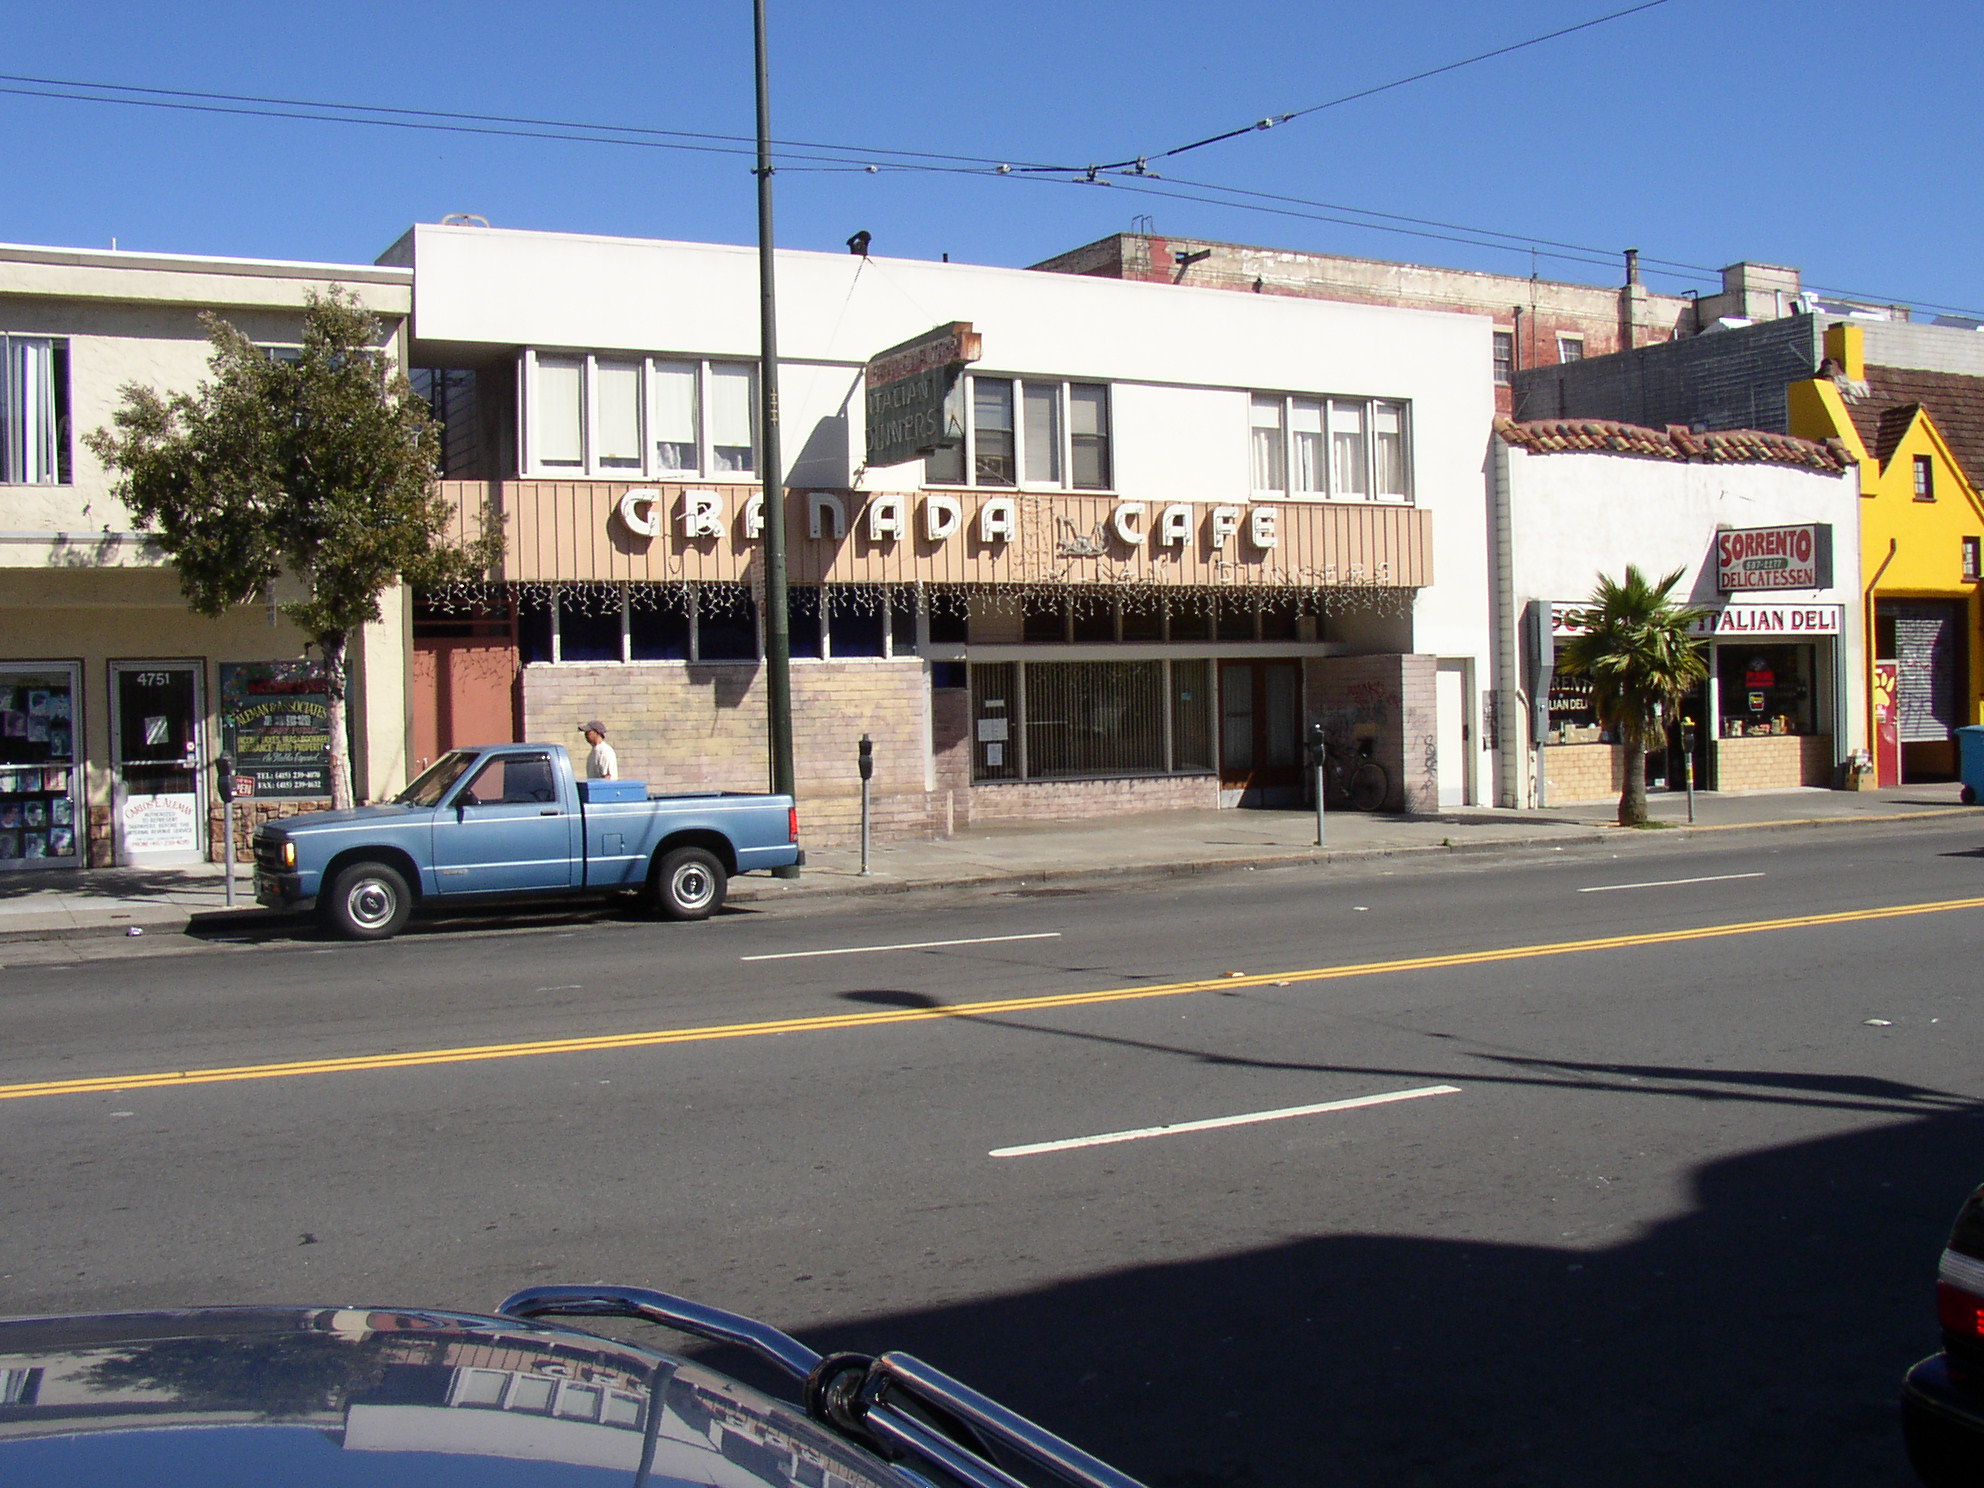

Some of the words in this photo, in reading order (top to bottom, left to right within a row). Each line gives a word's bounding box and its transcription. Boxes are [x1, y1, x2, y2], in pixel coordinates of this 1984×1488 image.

[620, 488, 1016, 543] GRANADA
[1110, 502, 1279, 549] CAFE
[1720, 528, 1812, 568] SORRENTO
[1721, 569, 1813, 588] DELICATESSEN
[1790, 609, 1837, 630] DELI
[136, 672, 170, 686] 4751
